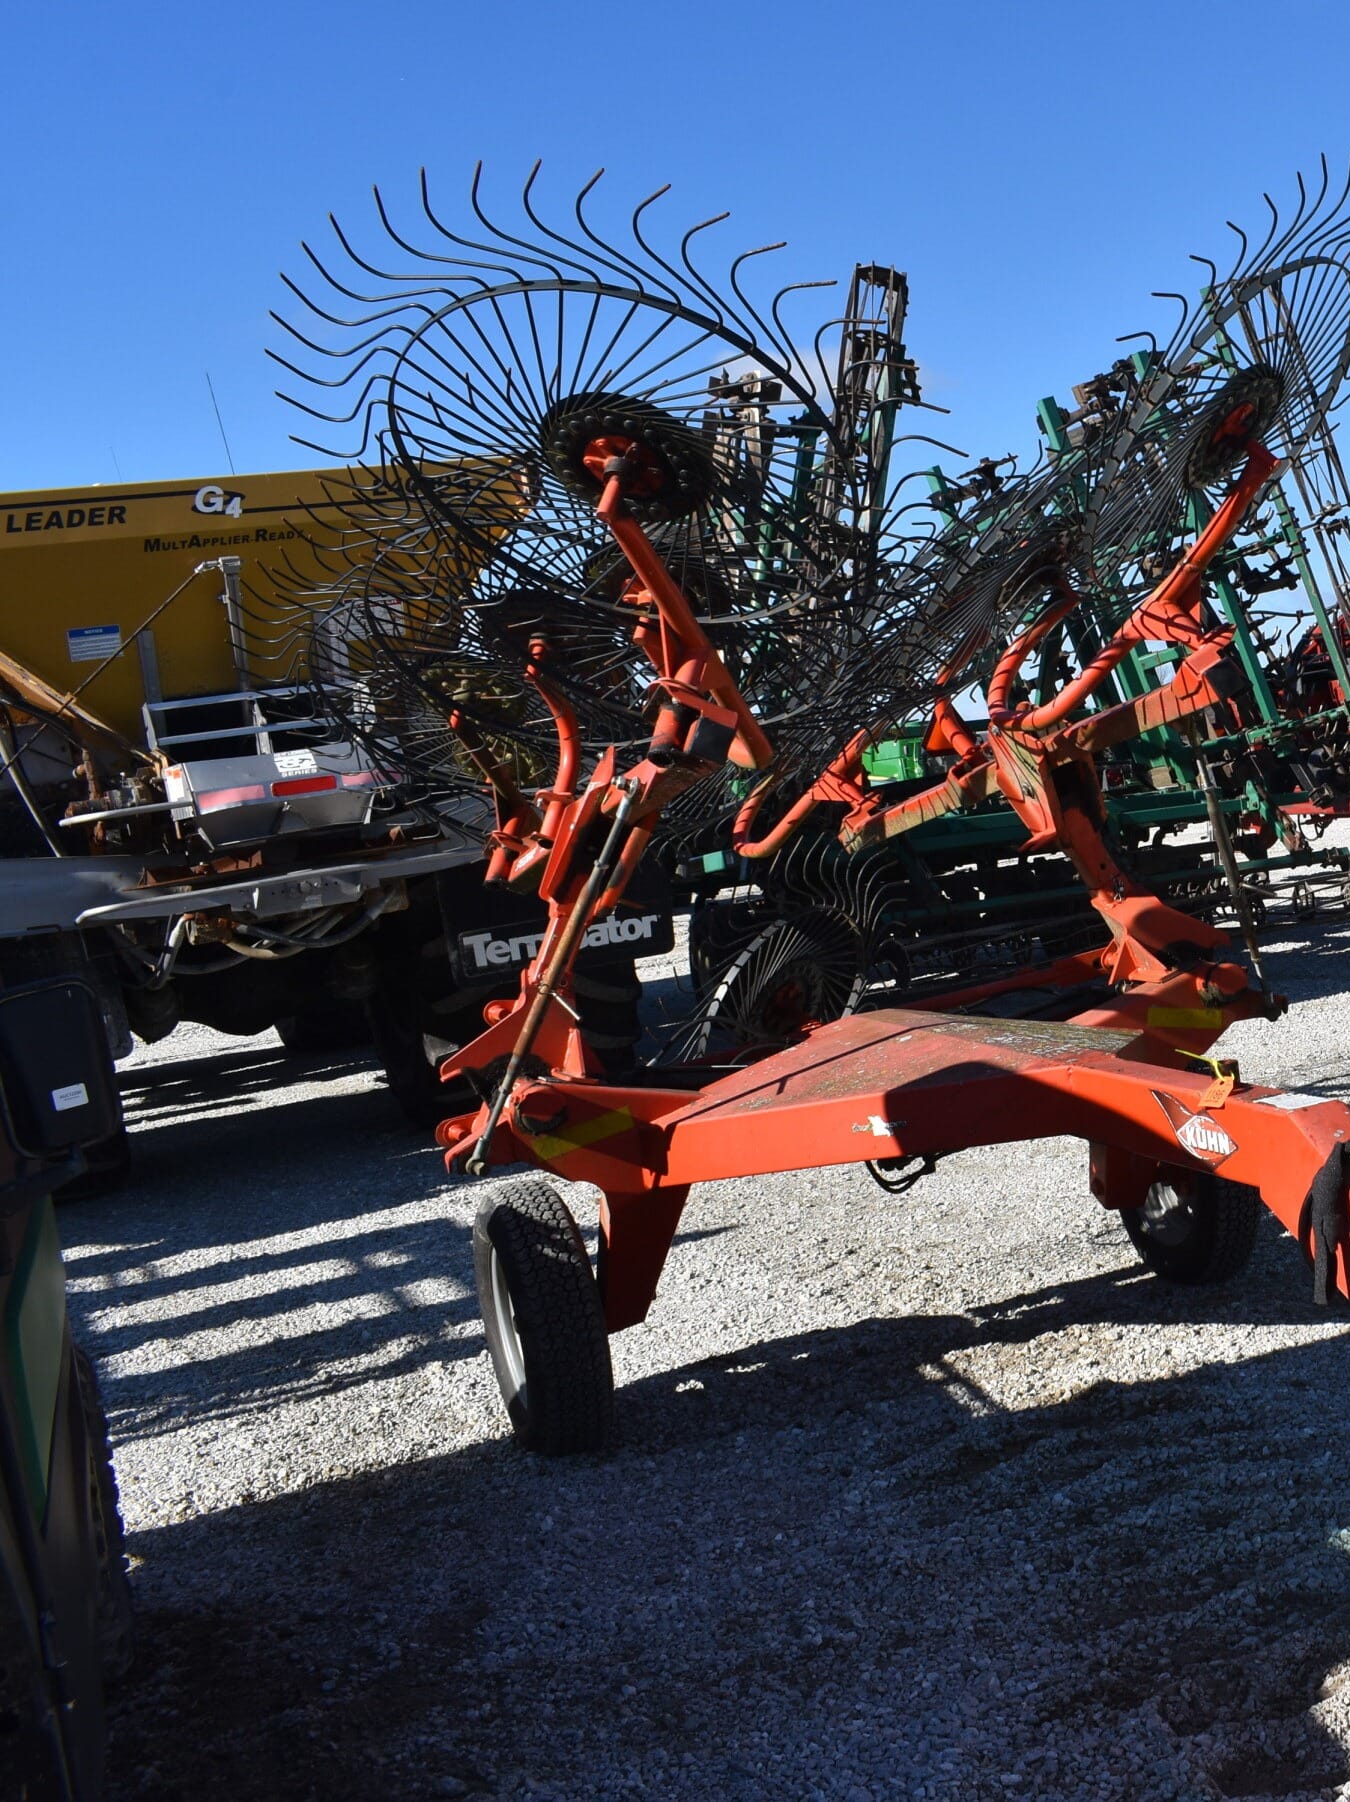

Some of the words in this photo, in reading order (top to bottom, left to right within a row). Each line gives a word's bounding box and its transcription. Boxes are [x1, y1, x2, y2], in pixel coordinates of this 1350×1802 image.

[193, 484, 244, 519] G4
[5, 504, 127, 534] LEADER
[462, 913, 658, 968] Terator
[1184, 1123, 1231, 1156] KUHN
